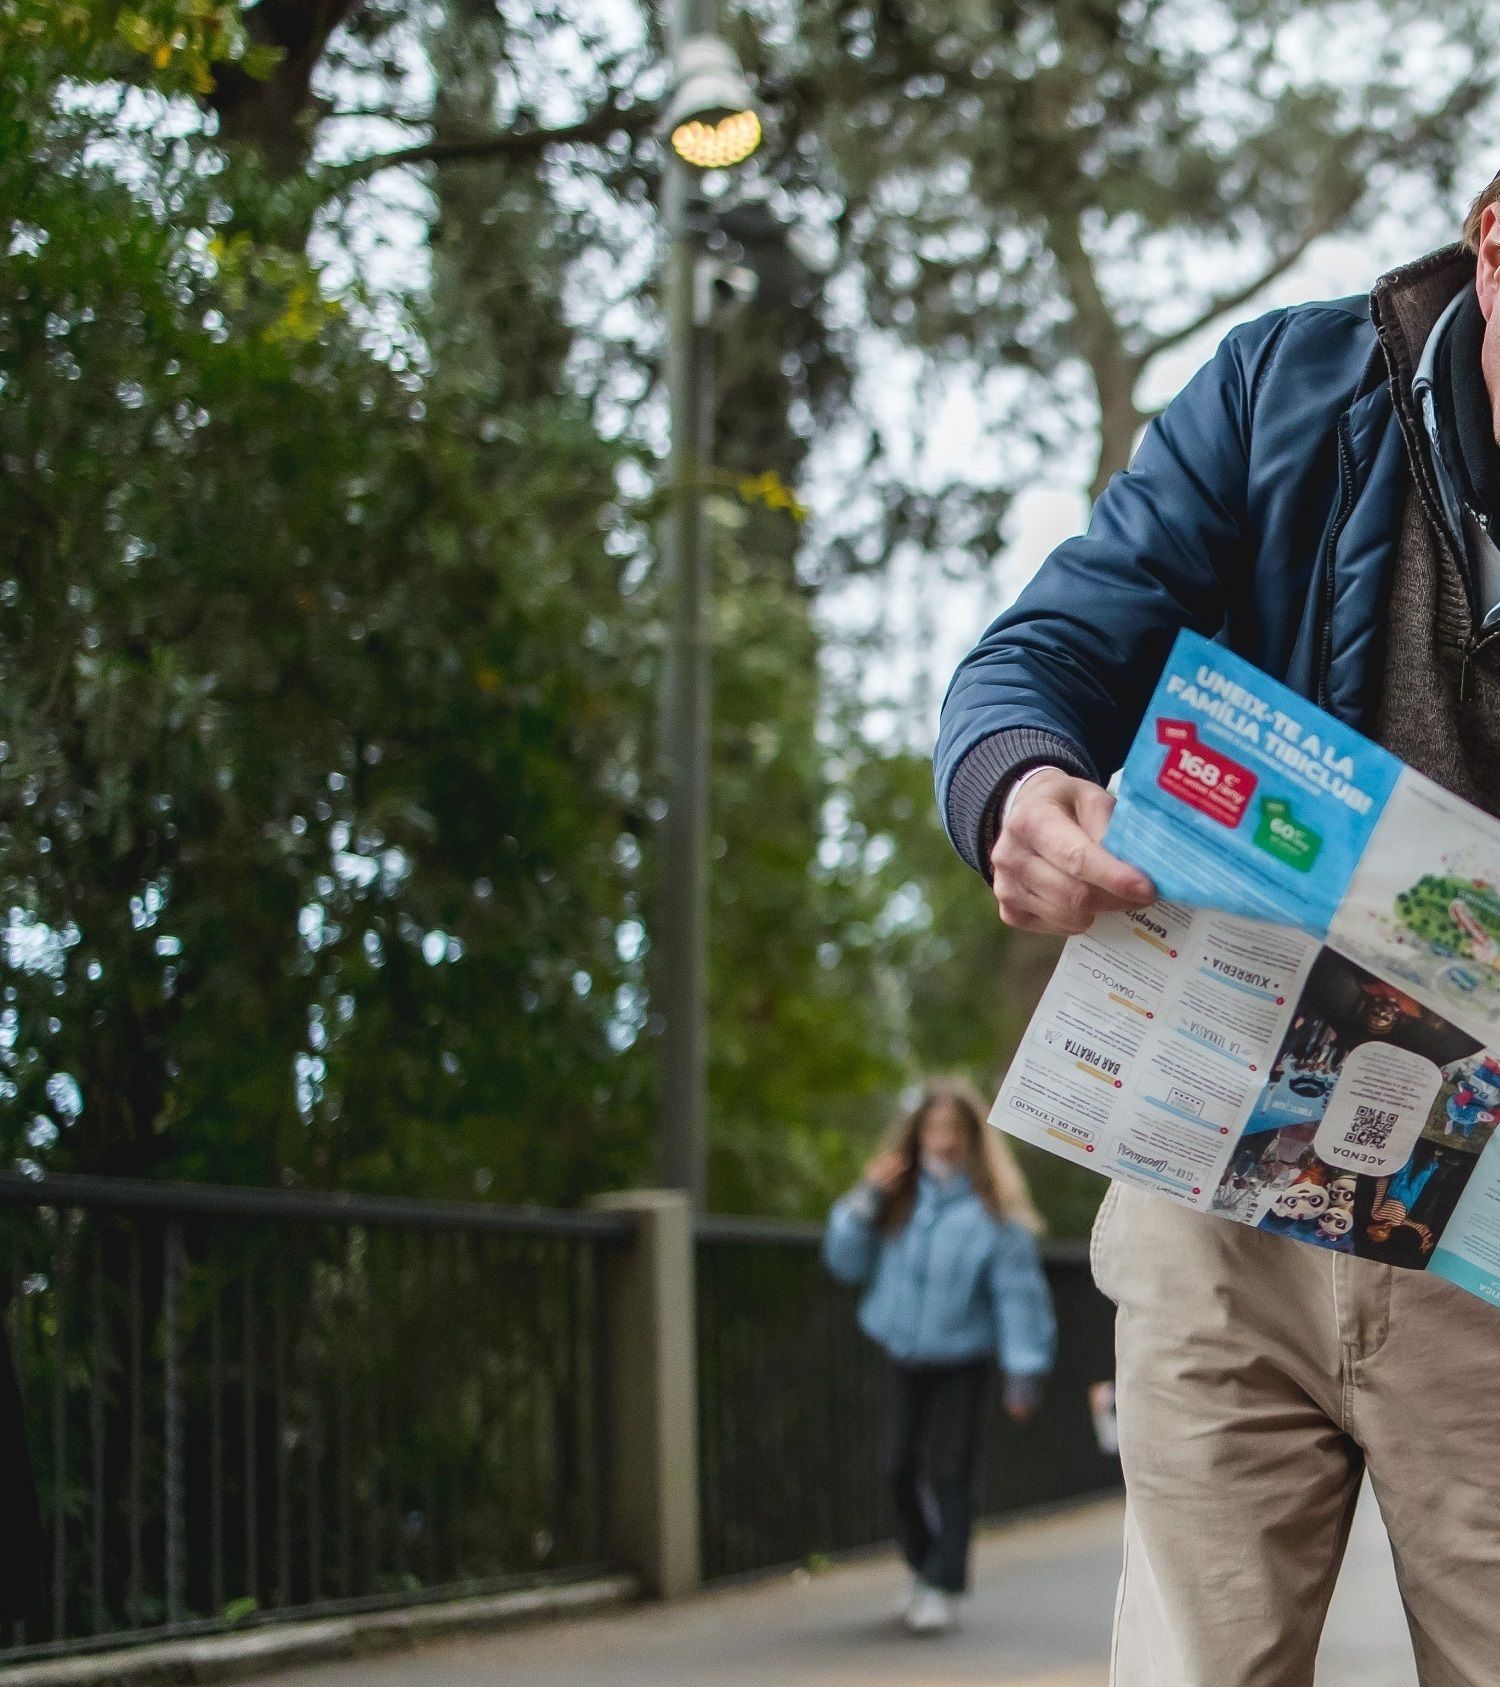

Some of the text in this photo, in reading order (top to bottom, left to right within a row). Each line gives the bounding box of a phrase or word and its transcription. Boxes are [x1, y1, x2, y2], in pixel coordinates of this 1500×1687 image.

[1196, 665, 1353, 778] UNEIX-TE A LA
[1166, 675, 1259, 741] FAMÍLIA
[1264, 732, 1373, 814] TIBICLUB!
[1177, 748, 1219, 787] 168
[1271, 818, 1294, 840] 60
[1089, 968, 1135, 998] DIAVOLO
[1210, 957, 1269, 988] XURRERIA
[1190, 1020, 1241, 1053] LA TERRASSA
[1064, 1037, 1121, 1075] BAR PIRATTA
[1055, 1119, 1068, 1128] DE
[1070, 1126, 1089, 1138] BAR
[1116, 1142, 1194, 1181] CLUB Aventurers
[1333, 1146, 1386, 1166] AGENDA
